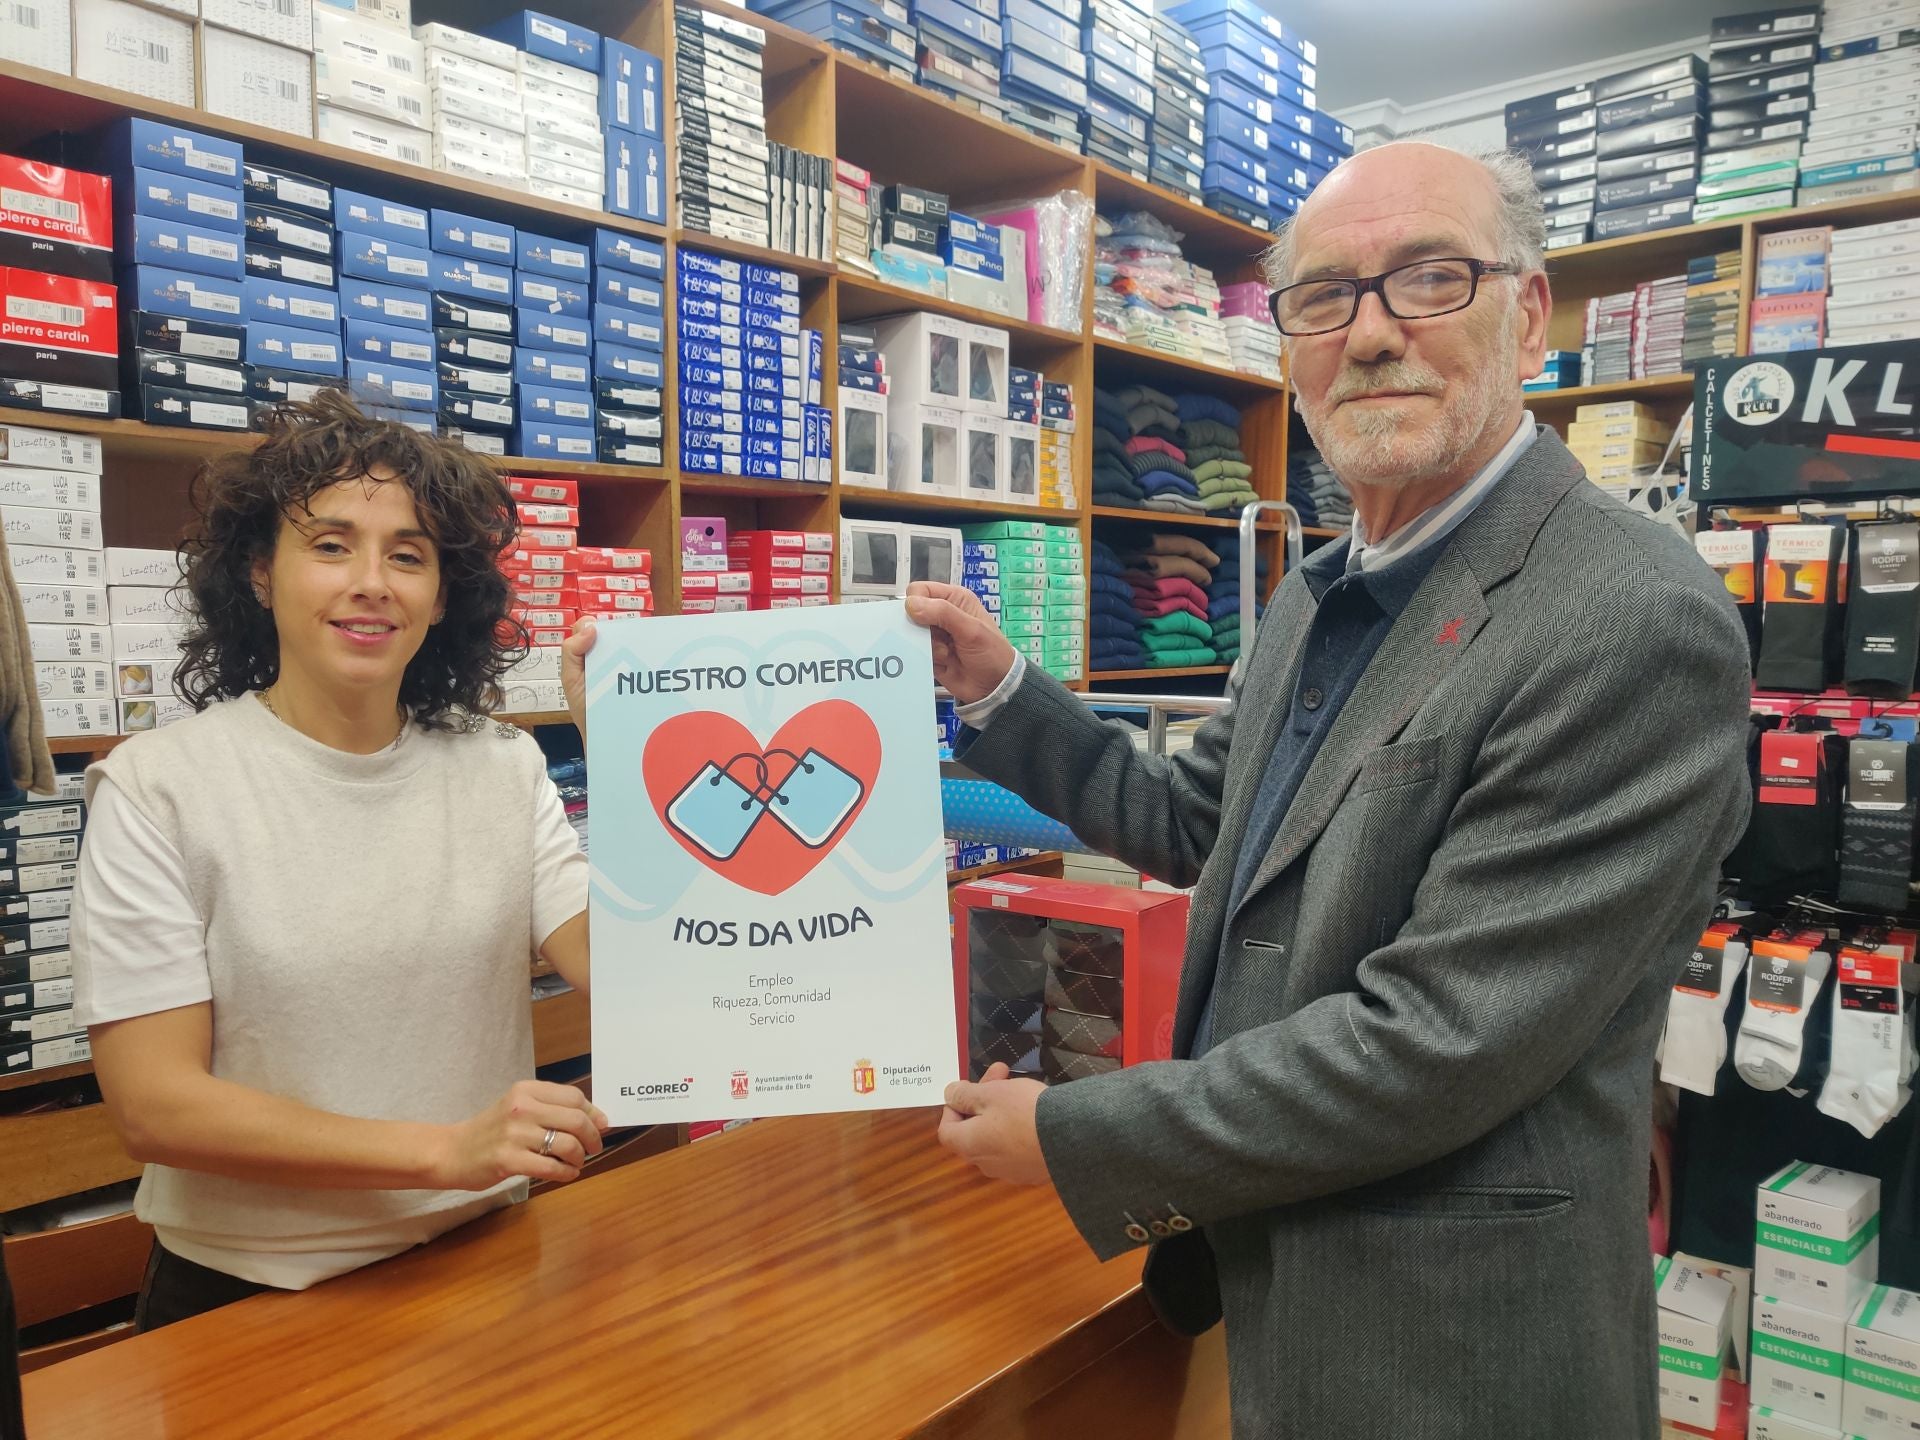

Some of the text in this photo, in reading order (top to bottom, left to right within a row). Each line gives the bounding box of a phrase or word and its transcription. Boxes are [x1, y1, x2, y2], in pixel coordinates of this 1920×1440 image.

[0, 210, 88, 236] pierre cardin
[32, 241, 54, 252] paris
[443, 271, 471, 281] GUASCH
[2, 321, 90, 344] pierre cardin
[36, 351, 58, 361] paris
[1701, 368, 1716, 491] CALCETINES
[57, 512, 73, 525] LUCIA
[1871, 555, 1906, 565] RODFER
[66, 628, 82, 641] LUCIA
[70, 666, 86, 679] LUCIA
[617, 655, 904, 695] NUESTRO COMERCIO
[673, 906, 873, 947] NOS DA VIDA
[749, 973, 794, 990] Empleo
[1761, 973, 1794, 985] RODFER
[712, 988, 831, 1012] Riqueza, Comunidad
[749, 1012, 795, 1026] Servicio
[882, 1064, 932, 1077] Diputación
[755, 1075, 802, 1085] Ayuntamiento
[889, 1074, 932, 1088] de Burgos
[620, 1082, 690, 1096] EL CORREO
[755, 1082, 811, 1093] Miranda de Ebro
[1765, 1211, 1822, 1231] abanderado
[1763, 1231, 1832, 1256] ESENCIALES
[1761, 1320, 1820, 1342] abanderado
[1760, 1341, 1830, 1367] ESENCIALES
[1854, 1346, 1918, 1370] abanderado
